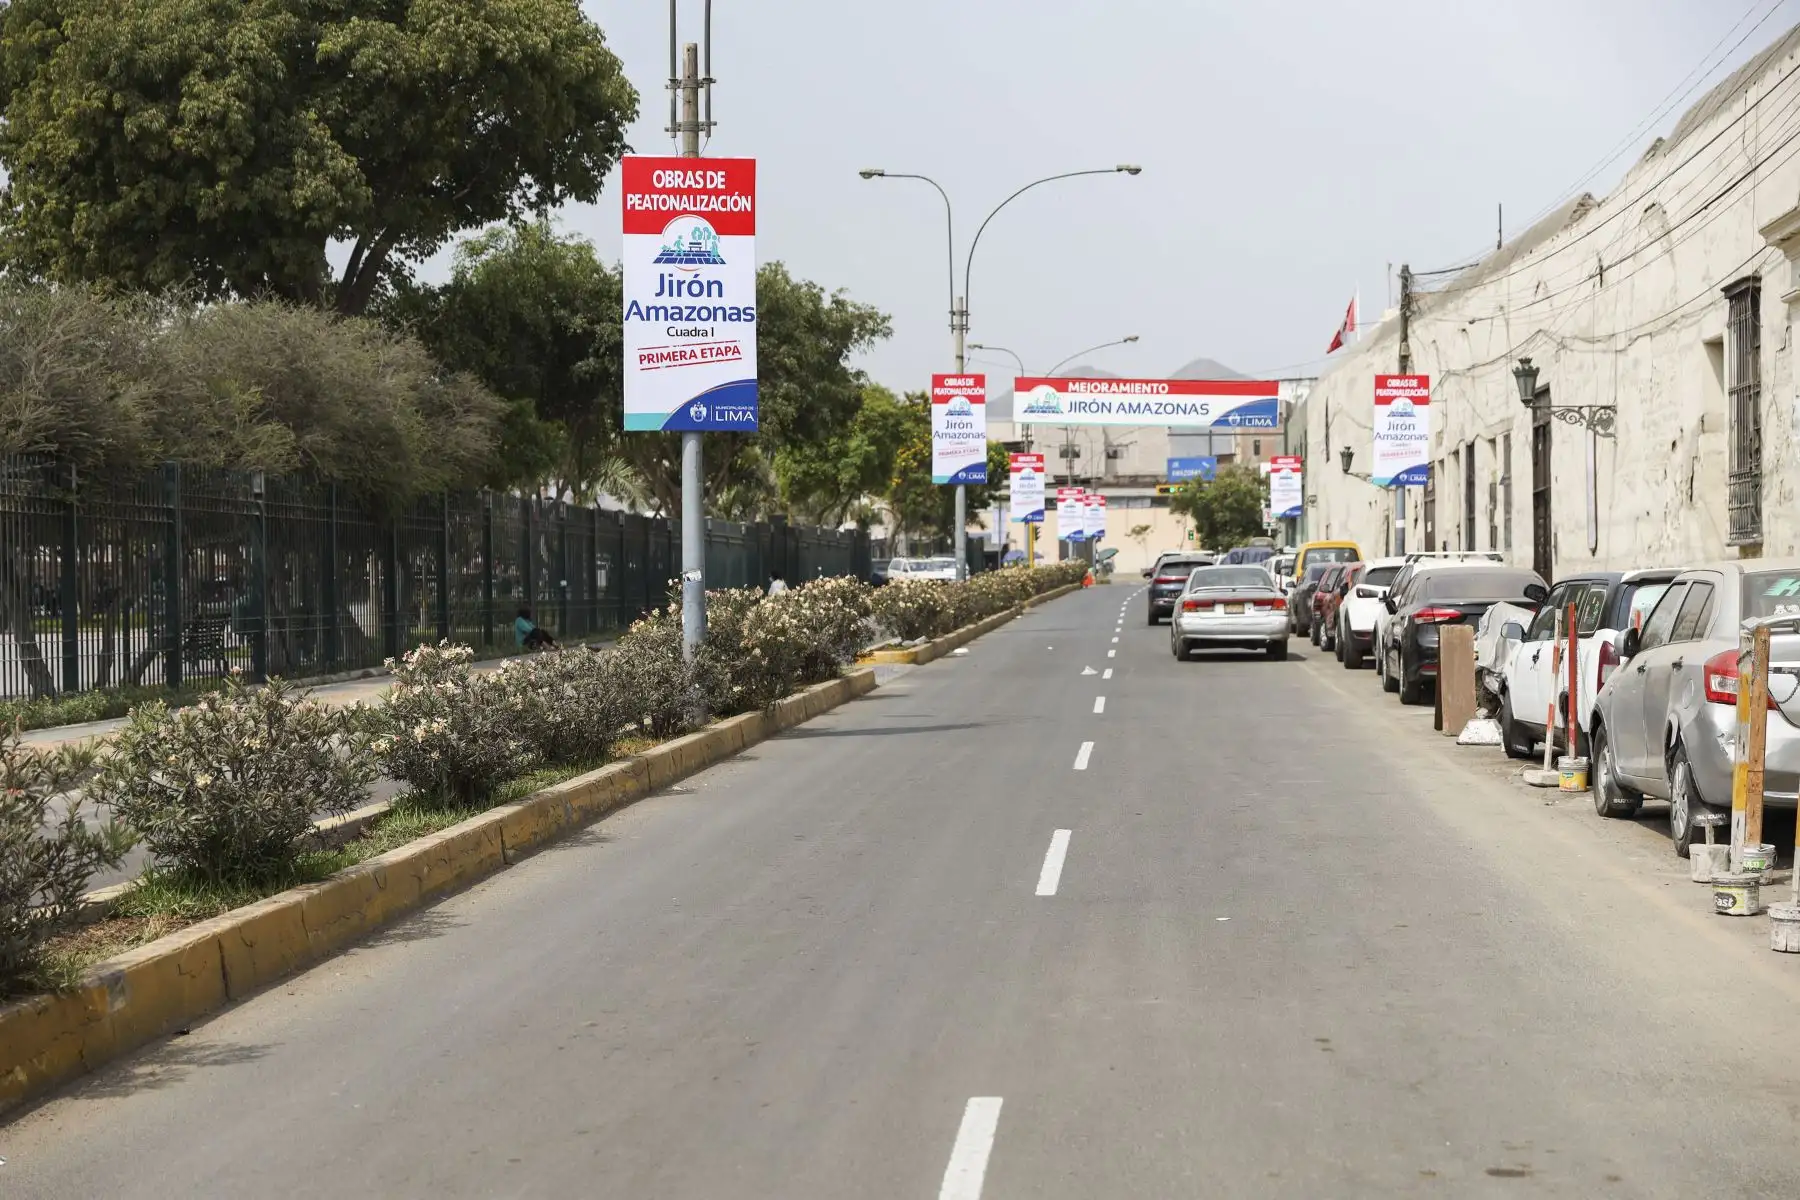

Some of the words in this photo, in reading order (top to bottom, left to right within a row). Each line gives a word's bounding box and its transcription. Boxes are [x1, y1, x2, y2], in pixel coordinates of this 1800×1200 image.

[652, 169, 704, 189] OBRAS
[706, 170, 726, 189] DE
[626, 192, 752, 212] PEATONALIZACIÓN
[655, 273, 723, 298] Jirón
[624, 300, 756, 322] Amazonas
[666, 326, 708, 337] Cuadra
[639, 349, 701, 365] PRIMERA
[700, 345, 741, 359] ETAPA
[1068, 381, 1169, 395] MEJORAMIENTO
[1068, 398, 1112, 414] JIRÓN
[1115, 401, 1210, 416] AMAZONAS
[715, 410, 755, 421] LIMA
[945, 420, 973, 430] Jirón
[1245, 418, 1273, 427] LIMA
[1387, 421, 1416, 431] Jirón
[933, 430, 986, 440] Amazonas
[1374, 432, 1428, 441] Amazonas
